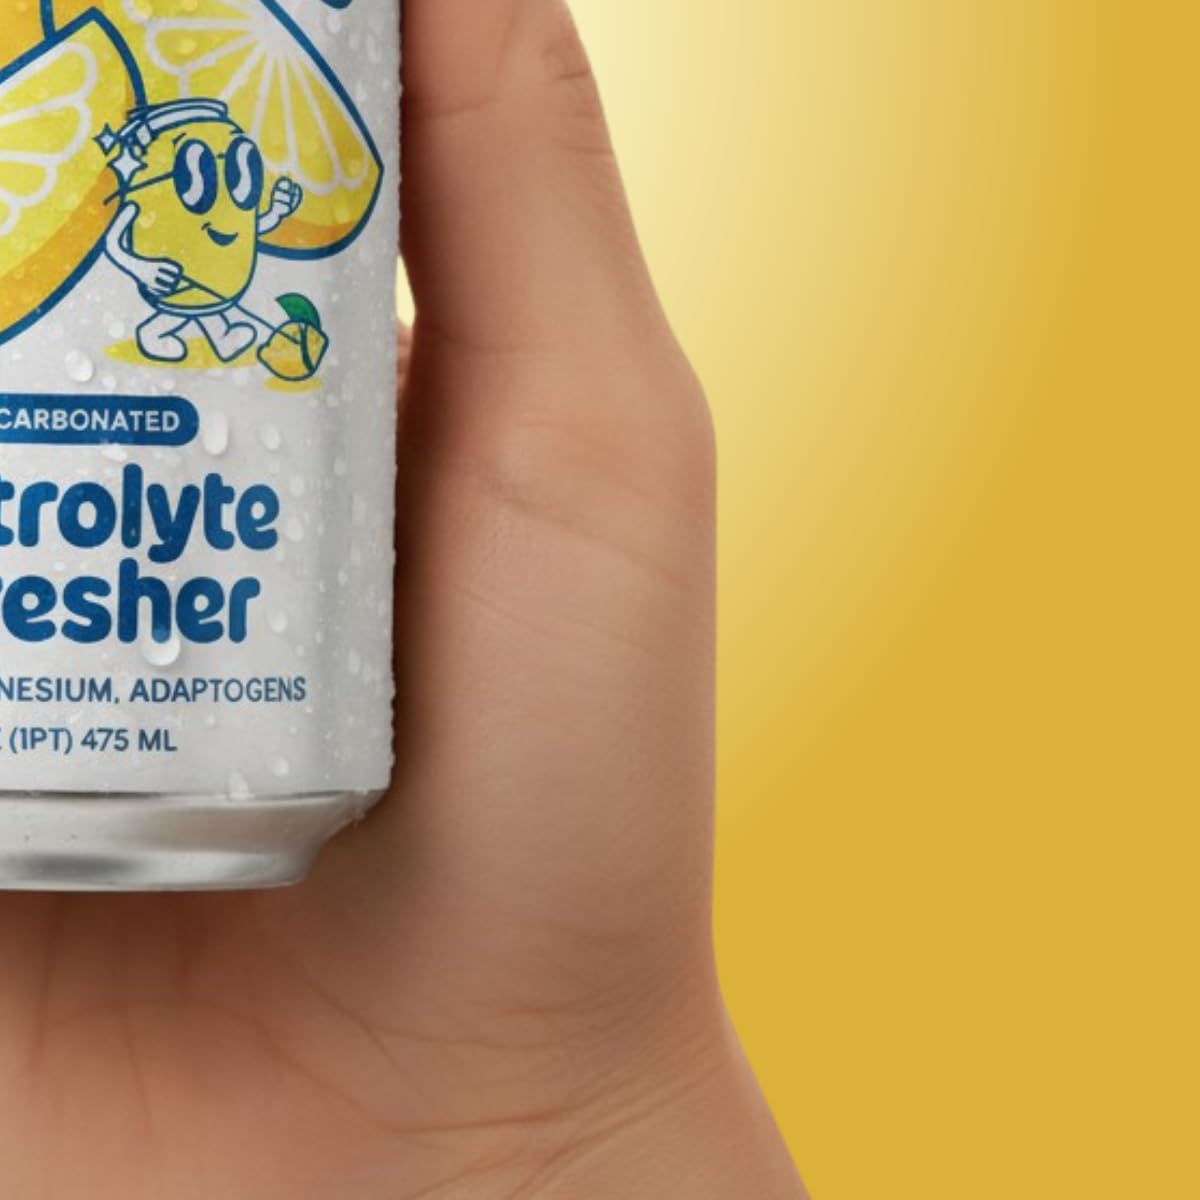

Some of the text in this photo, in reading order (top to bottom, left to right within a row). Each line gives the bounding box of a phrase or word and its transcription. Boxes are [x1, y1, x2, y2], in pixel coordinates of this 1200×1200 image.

[129, 677, 306, 702] ADAPTOGENS
[9, 727, 73, 754] (1PT)
[81, 728, 129, 751] 475
[138, 729, 178, 751] ML
